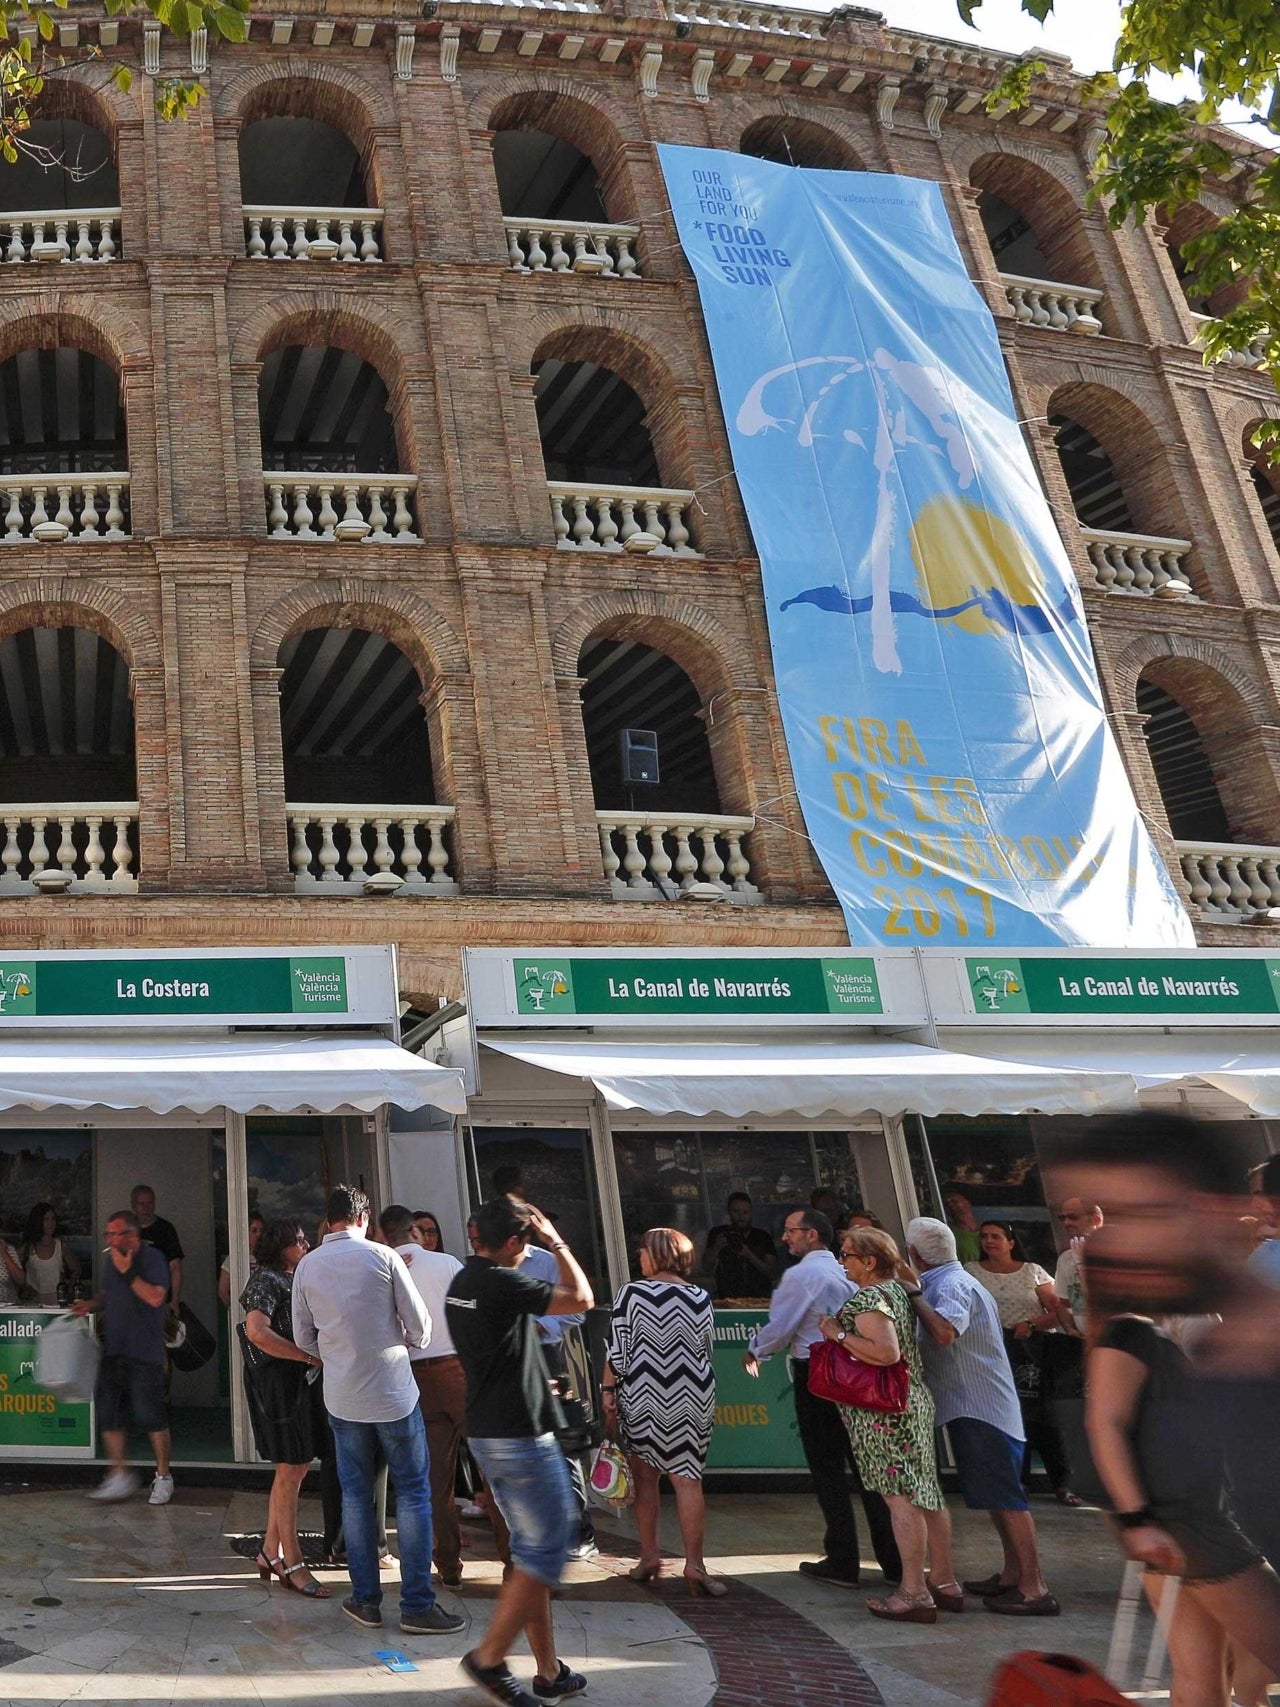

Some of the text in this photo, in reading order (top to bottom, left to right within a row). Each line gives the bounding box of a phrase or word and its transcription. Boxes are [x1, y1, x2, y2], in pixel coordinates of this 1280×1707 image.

[692, 169, 722, 186] OUR
[696, 184, 732, 202] LAND
[700, 201, 758, 222] FOR YOU
[705, 221, 766, 246] FOOD
[712, 245, 792, 268] LIVING
[722, 265, 772, 287] SUN
[819, 714, 927, 766] FIRA
[831, 771, 987, 824] DE LES
[871, 885, 997, 938] 2017
[117, 977, 210, 998] La Costera
[299, 982, 339, 992] València
[301, 972, 341, 982] València
[608, 977, 792, 998] La Canal de Navarrés
[833, 974, 873, 984] València
[1058, 976, 1240, 997] La Canal de Navarrés
[303, 992, 342, 1002] Turisme
[832, 984, 873, 993] València
[837, 993, 876, 1003] Turisme
